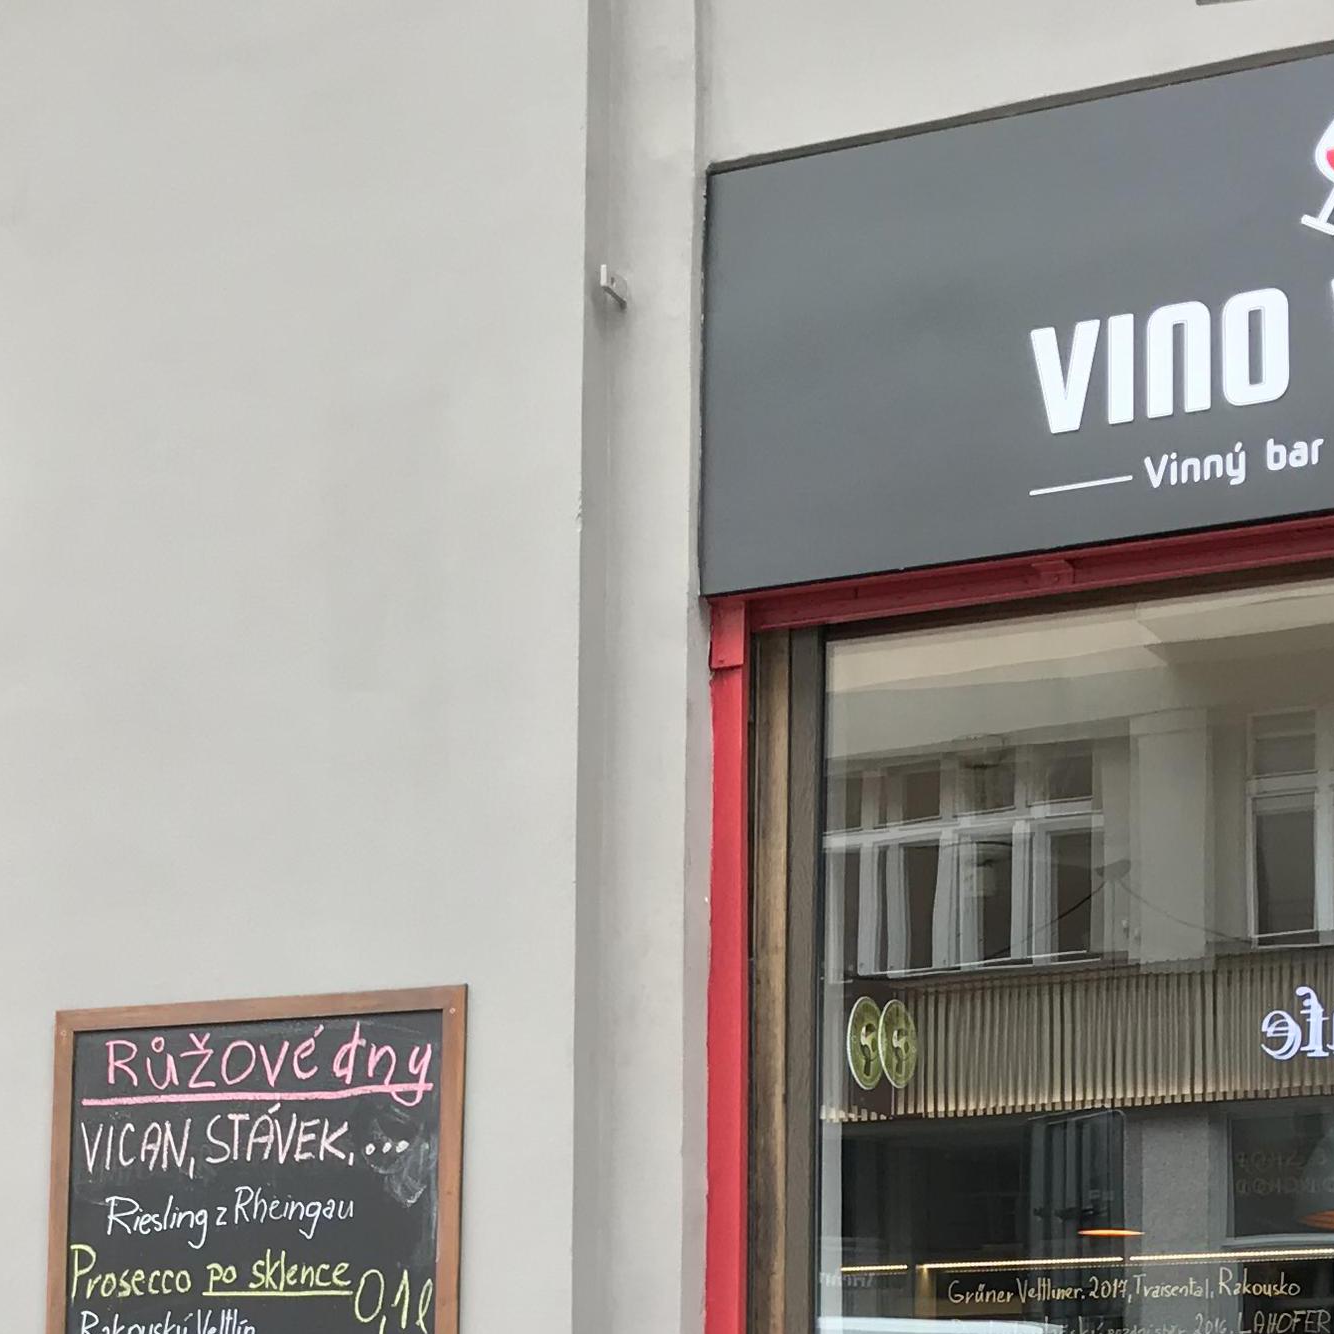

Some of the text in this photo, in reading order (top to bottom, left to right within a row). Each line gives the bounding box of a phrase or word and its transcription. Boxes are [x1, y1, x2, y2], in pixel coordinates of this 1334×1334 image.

[1029, 288, 1290, 435] VINO
[1143, 442, 1247, 489] Vinný
[1266, 436, 1325, 472] bar
[105, 1195, 208, 1250] Riesling
[233, 1185, 355, 1240] Rheingau
[70, 1244, 193, 1304] Prosecco
[203, 1260, 238, 1293] po
[248, 1248, 351, 1293] sklence
[1218, 1266, 1301, 1297] Rakousko
